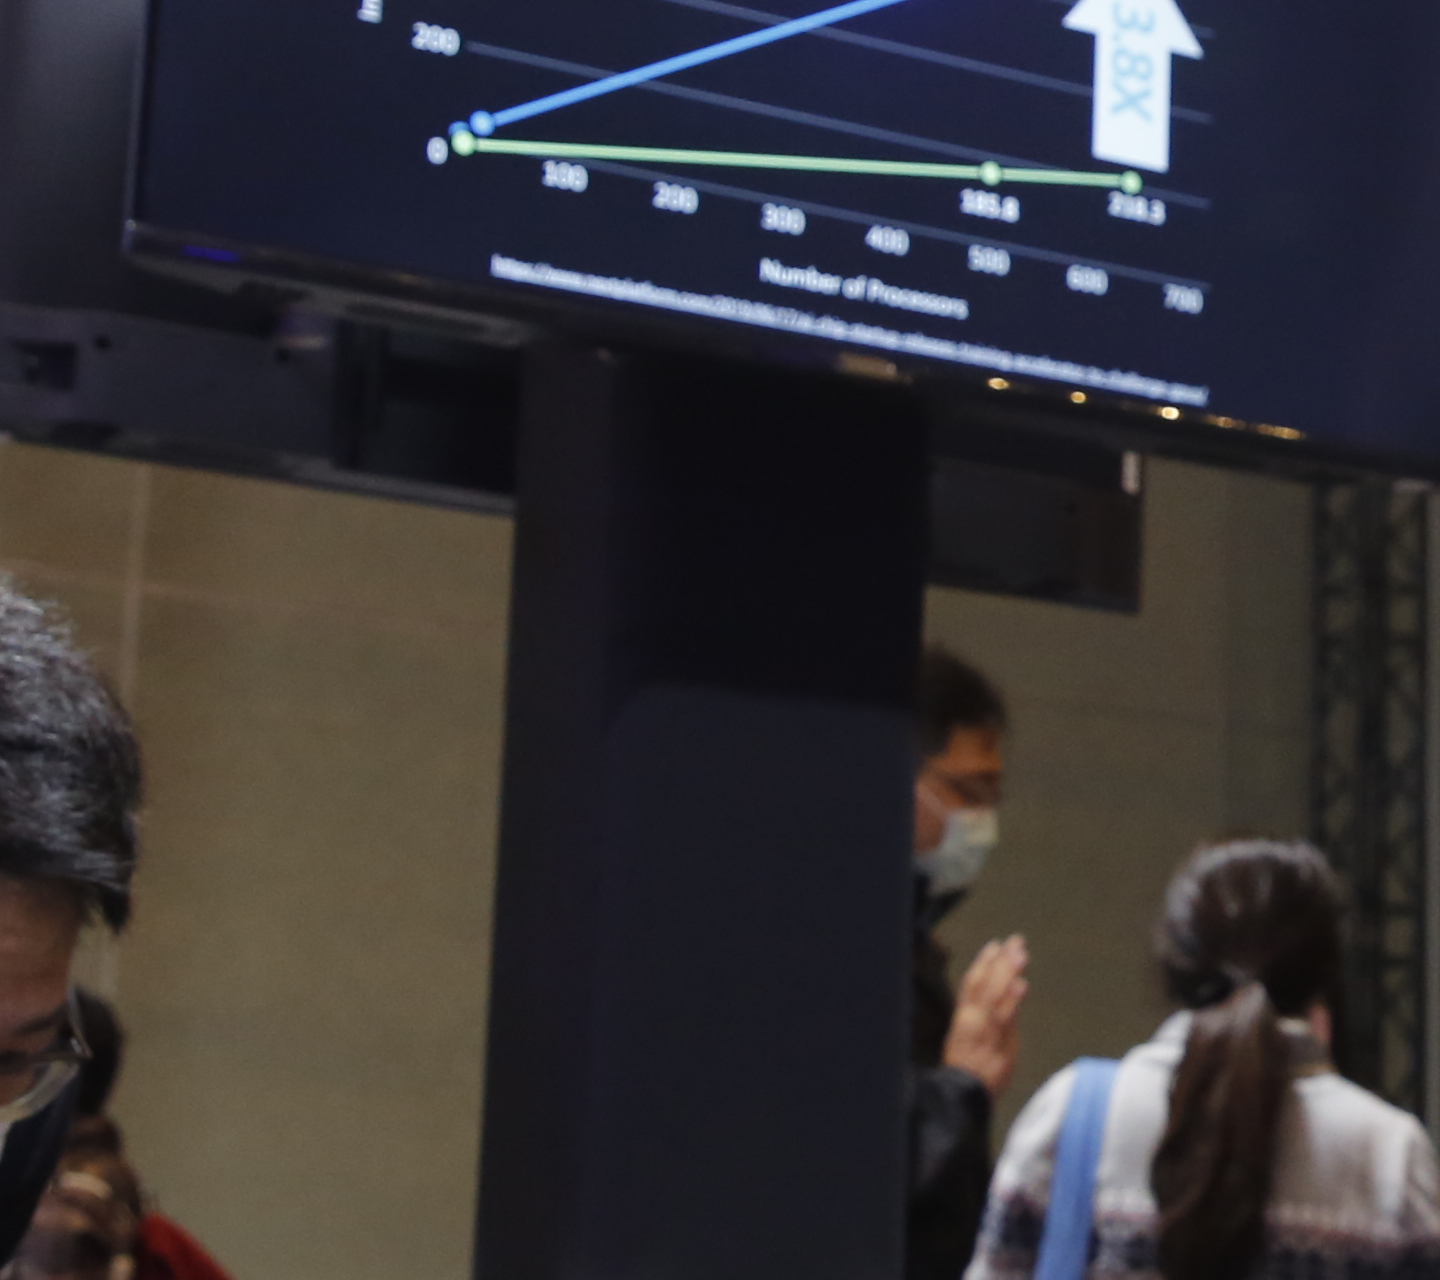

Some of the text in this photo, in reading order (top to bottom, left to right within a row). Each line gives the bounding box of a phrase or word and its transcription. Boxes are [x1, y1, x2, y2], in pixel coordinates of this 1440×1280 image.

[411, 21, 460, 57] 200
[1111, 0, 1156, 123] 3.8X
[426, 136, 449, 166] 0
[652, 181, 699, 214] 200
[761, 202, 806, 236] 300
[865, 224, 910, 257] 400
[967, 244, 1011, 277] 500
[1066, 264, 1109, 296] 600
[1164, 283, 1204, 314] 700
[759, 257, 842, 296] Number
[842, 275, 866, 301] of
[866, 277, 970, 320] Processors
